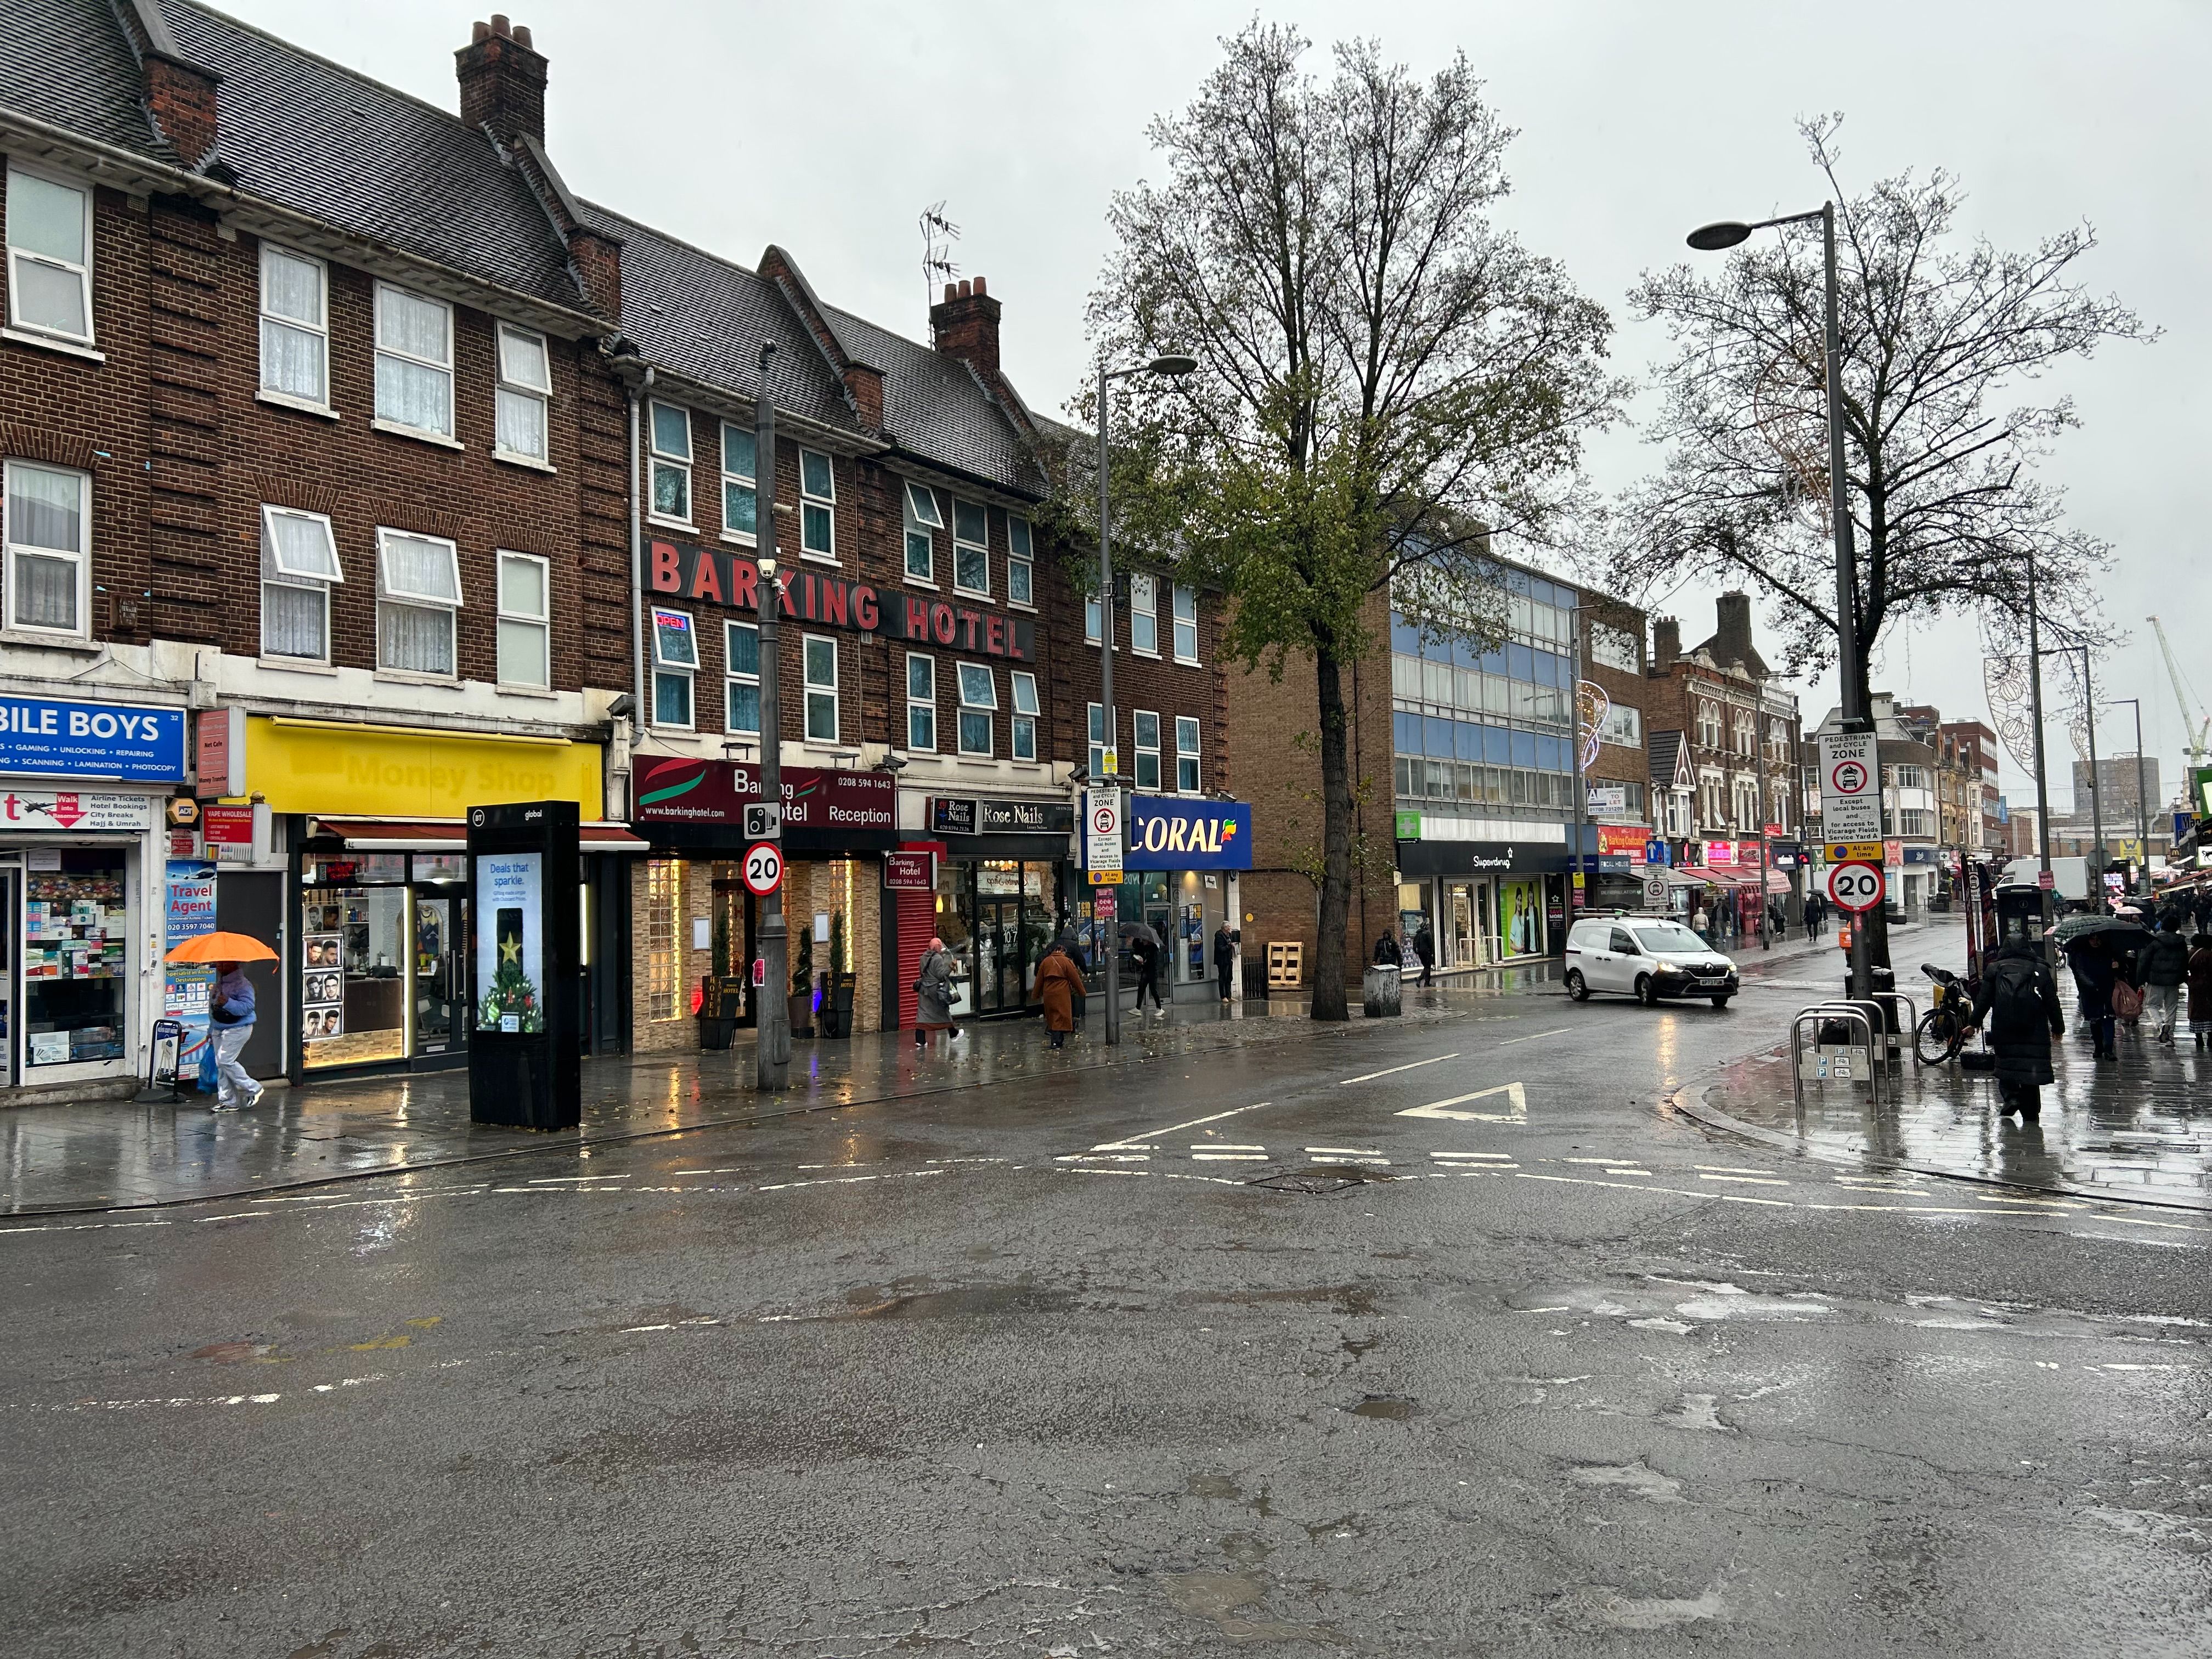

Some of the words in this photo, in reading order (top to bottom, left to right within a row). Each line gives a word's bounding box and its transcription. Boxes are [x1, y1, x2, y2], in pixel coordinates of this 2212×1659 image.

[651, 540, 881, 630] BARKING
[906, 596, 1024, 658] HOTEL
[656, 614, 684, 628] OPEN
[69, 710, 159, 741] BOYS
[1825, 734, 1872, 743] PEDESTRIAN
[15, 743, 50, 752] GAMING
[60, 747, 106, 755] UNLOCKING
[116, 749, 155, 758] REPAIRING
[1831, 748, 1866, 759] ZONE
[21, 758, 65, 767] SCANNING
[74, 761, 122, 769] LAMINATION
[132, 763, 176, 772] PHOTOCOPY
[347, 755, 466, 797] Money
[478, 763, 557, 799] Shop
[838, 777, 856, 786] 0208
[859, 778, 872, 788] 594
[874, 780, 891, 789] 1643
[645, 805, 725, 819] www.barkinghotel.com
[781, 801, 808, 822] tel
[949, 800, 969, 811] Rose
[525, 809, 543, 821] global
[829, 805, 891, 825] Reception
[947, 811, 970, 822] Nails
[983, 804, 1011, 823] Rose
[1014, 805, 1043, 824] Nails
[1609, 835, 1624, 848] Barking
[490, 863, 511, 873] Deals
[512, 862, 529, 872] that
[749, 857, 778, 879] 20
[889, 856, 915, 867] Barking
[1473, 855, 1511, 870] Superdrug
[900, 867, 921, 876] Hotel
[494, 875, 524, 888] sparkle.
[1837, 874, 1876, 896] 20
[171, 884, 212, 897] Travel
[171, 900, 212, 916] Agent
